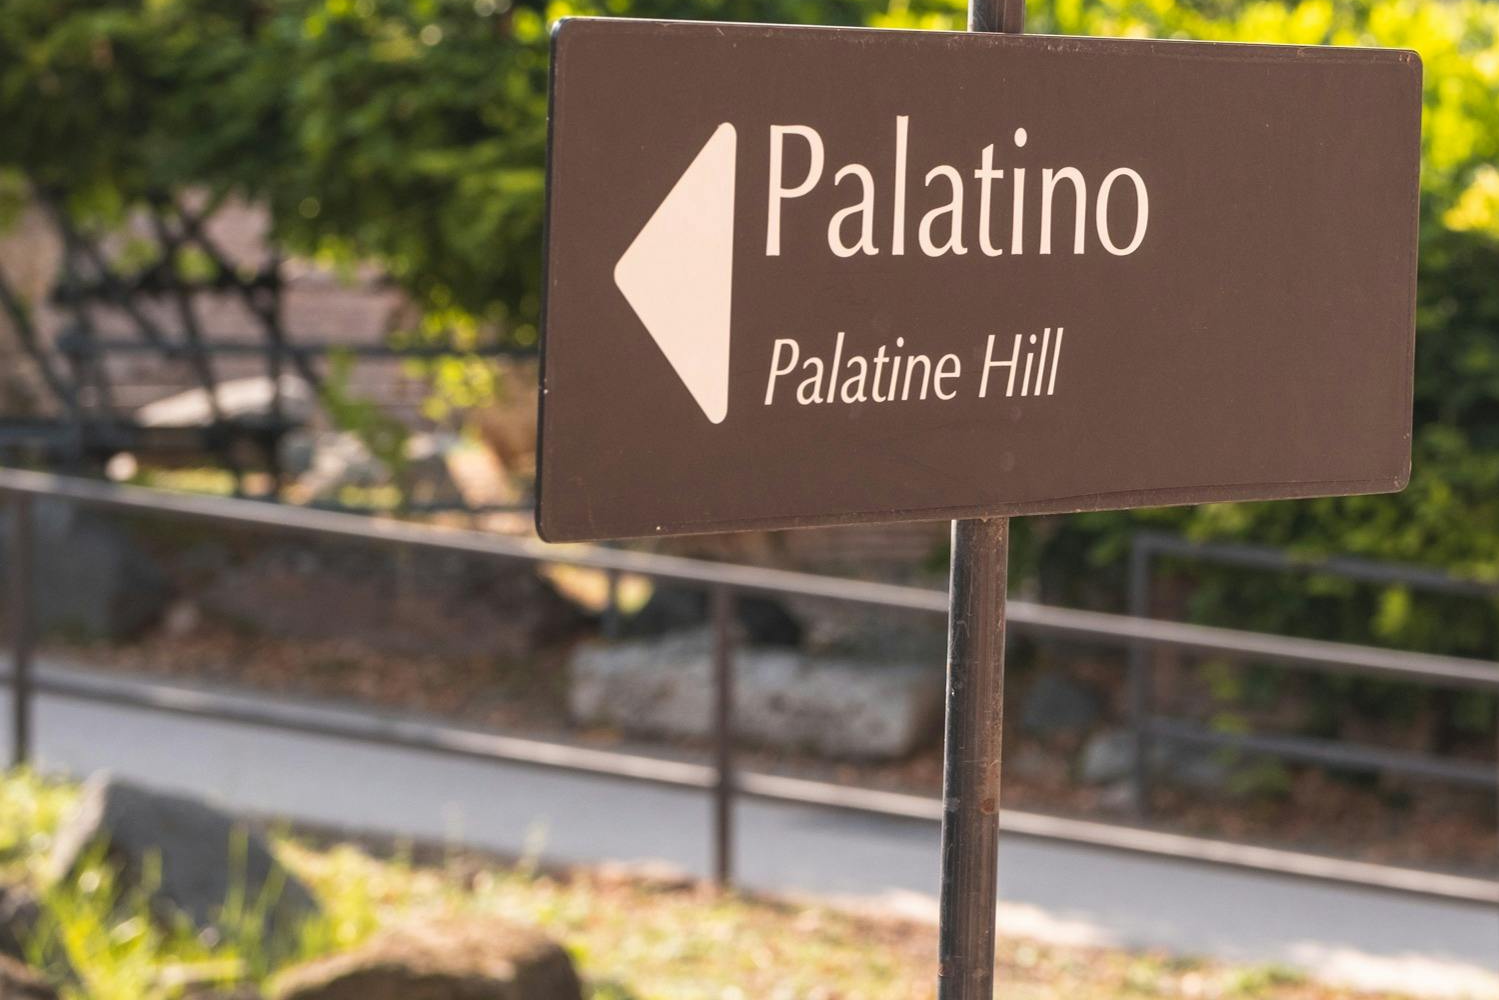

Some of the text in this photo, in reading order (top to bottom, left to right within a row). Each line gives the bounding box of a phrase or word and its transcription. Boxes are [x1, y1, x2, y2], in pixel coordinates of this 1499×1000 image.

[764, 115, 1150, 258] Palatino
[763, 327, 1065, 406] Palatine Hill
